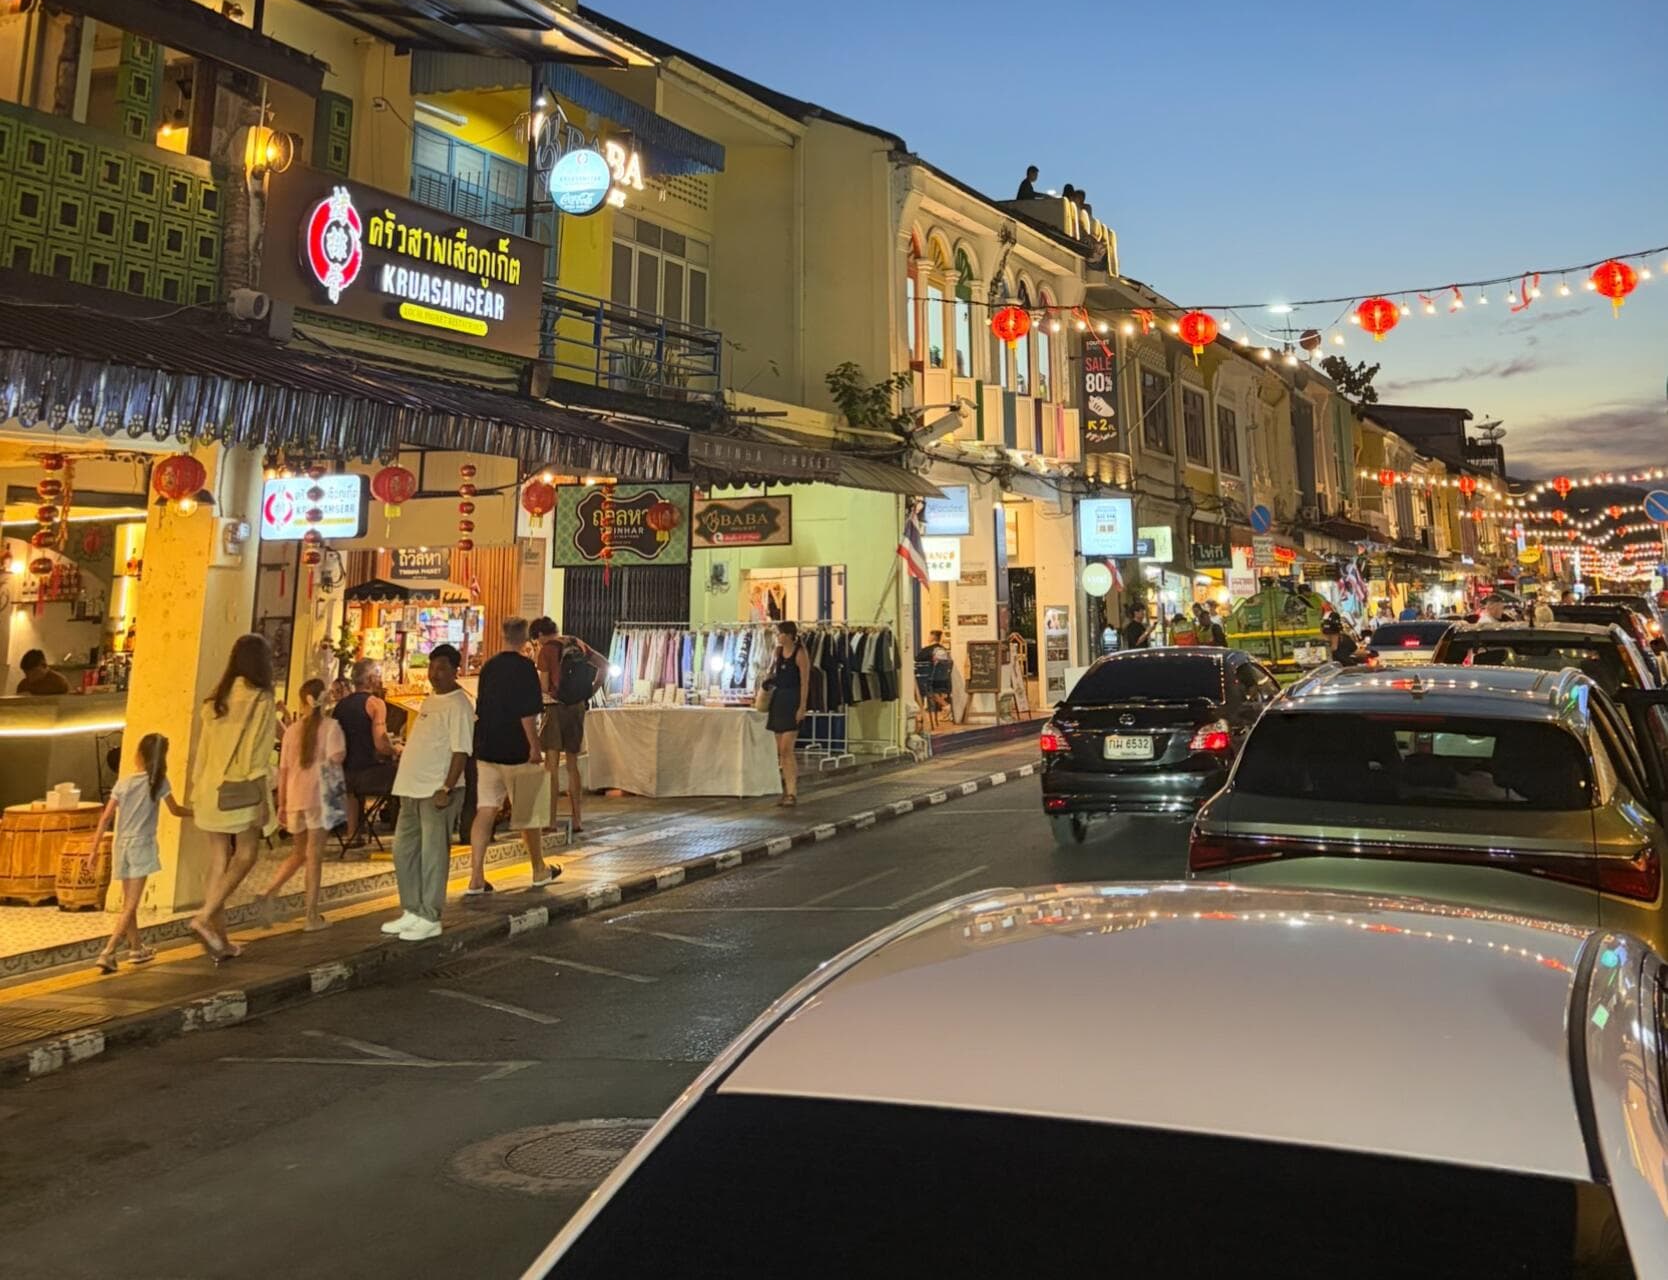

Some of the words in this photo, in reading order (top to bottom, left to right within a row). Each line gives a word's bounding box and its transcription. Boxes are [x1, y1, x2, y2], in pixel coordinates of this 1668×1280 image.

[381, 264, 505, 320] KRUASAMSEAR
[1085, 358, 1112, 372] SALE
[720, 513, 769, 526] BABA
[600, 526, 644, 535] TINHAR
[1126, 738, 1149, 750] 6532
